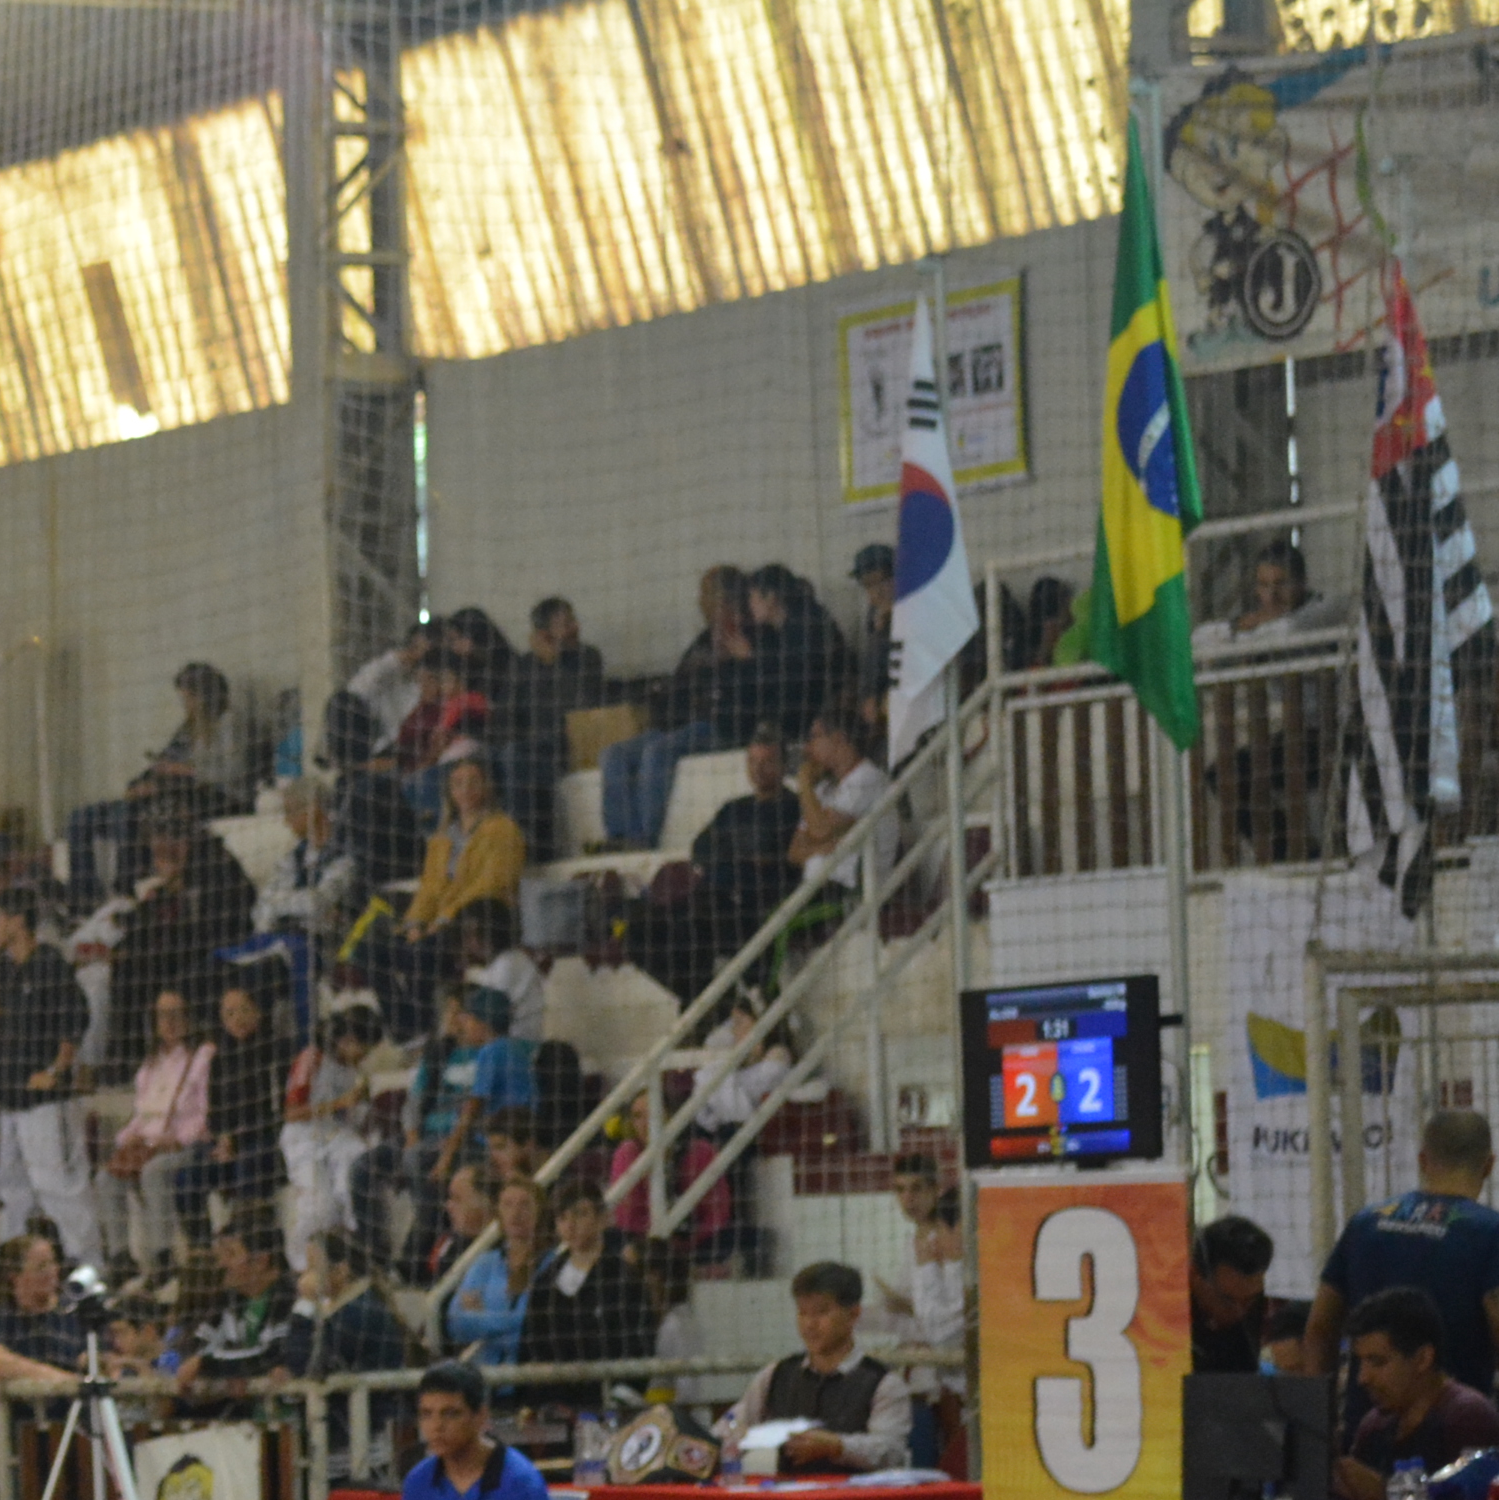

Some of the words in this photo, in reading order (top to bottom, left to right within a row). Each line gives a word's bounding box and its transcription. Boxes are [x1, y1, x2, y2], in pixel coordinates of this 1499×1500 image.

[1015, 1072, 1039, 1117] 2
[1078, 1067, 1103, 1113] 2
[1031, 1205, 1142, 1494] 3
